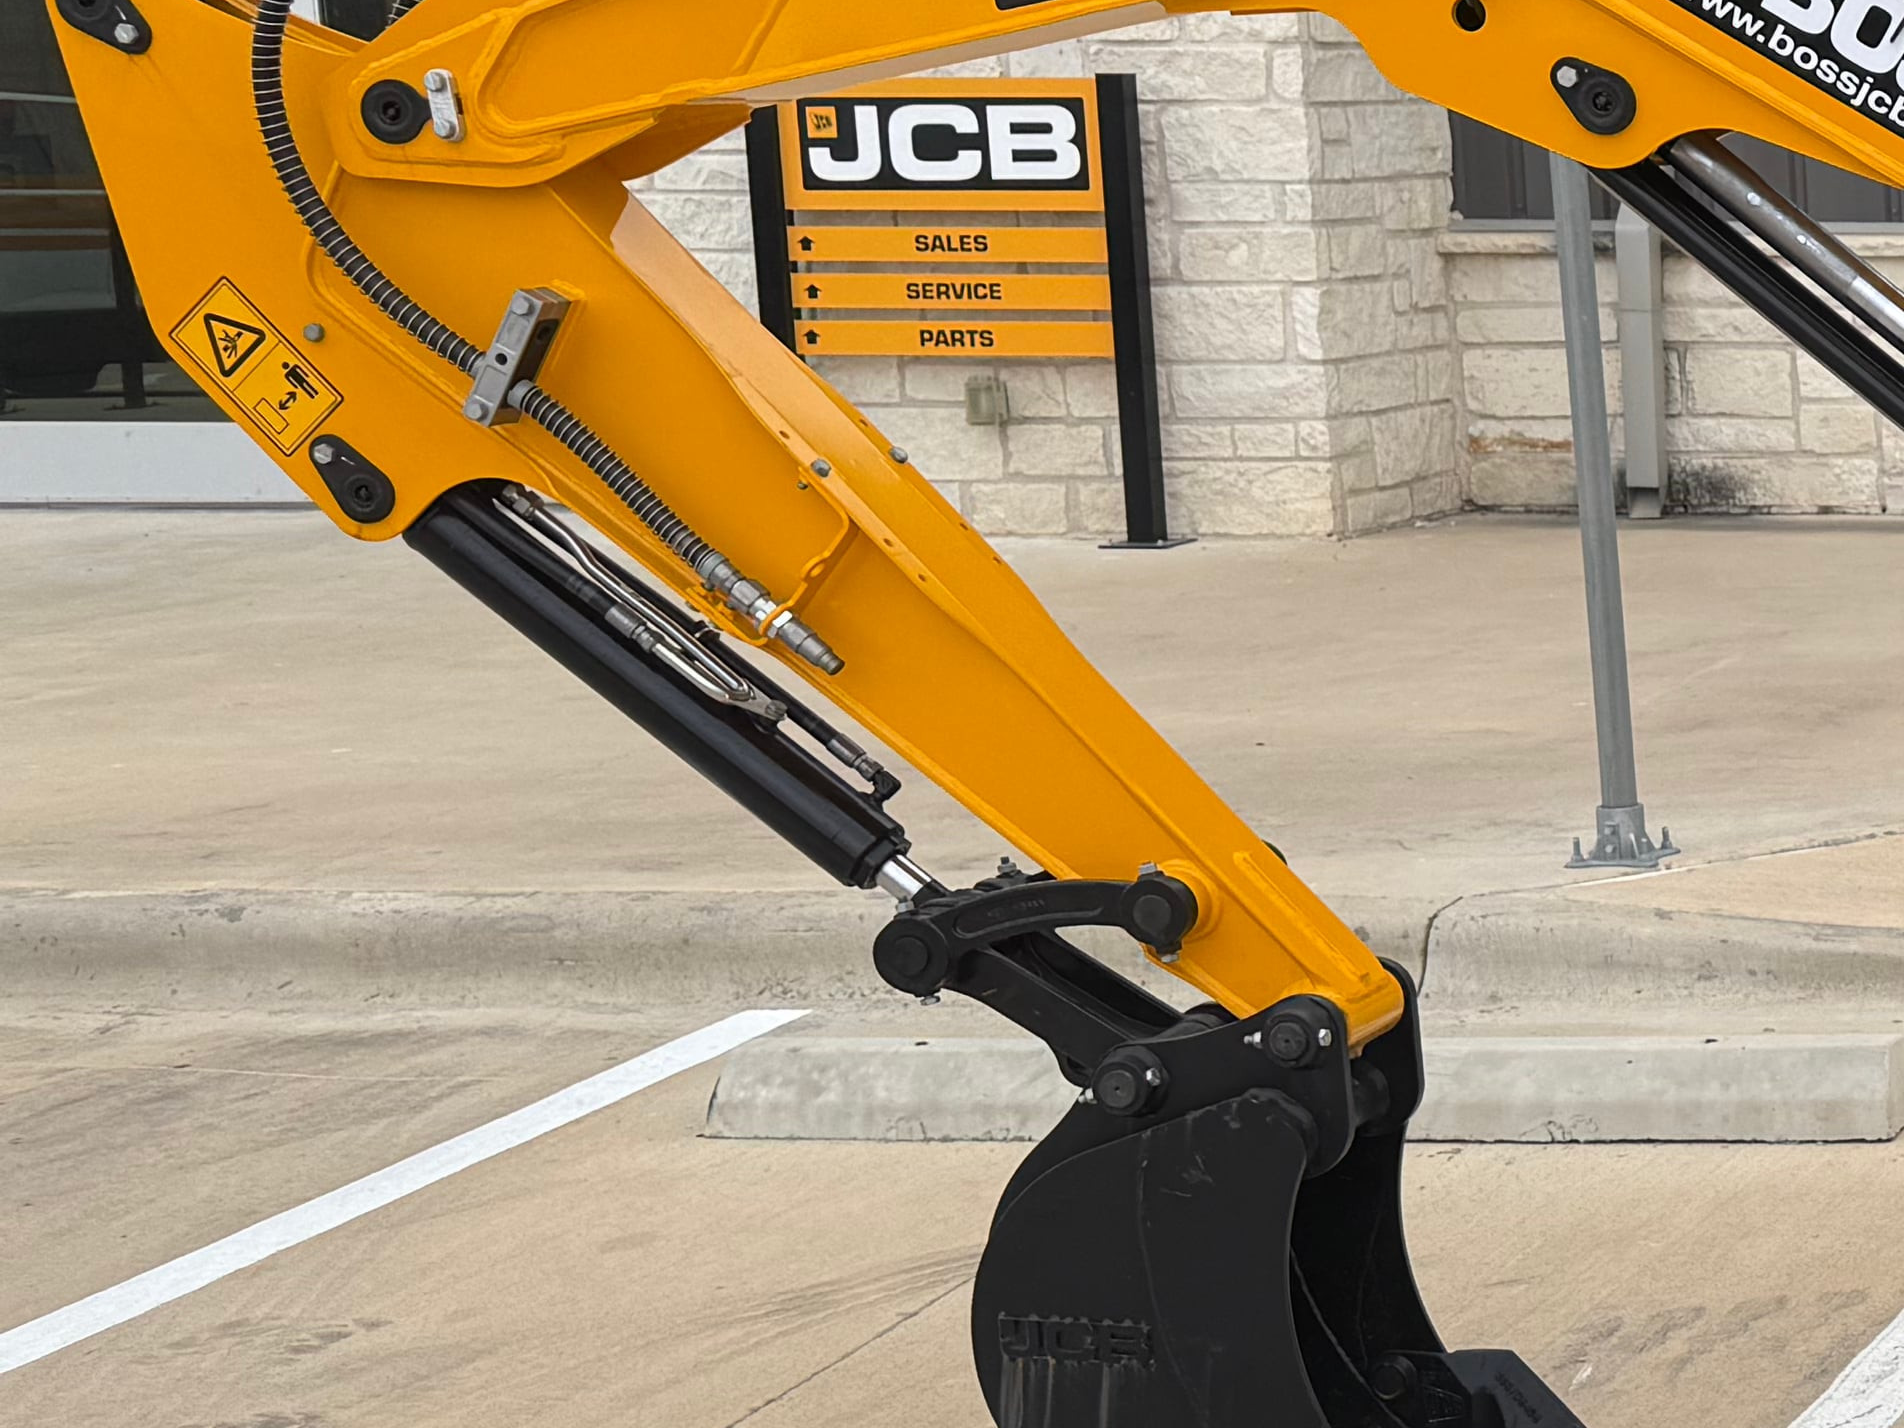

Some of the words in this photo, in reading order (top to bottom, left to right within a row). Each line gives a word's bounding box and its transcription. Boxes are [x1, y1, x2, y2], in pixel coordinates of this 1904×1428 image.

[808, 104, 1081, 182] JCB
[914, 234, 988, 253] SALES
[906, 282, 1002, 300] SERVICE
[919, 329, 994, 348] PARTS
